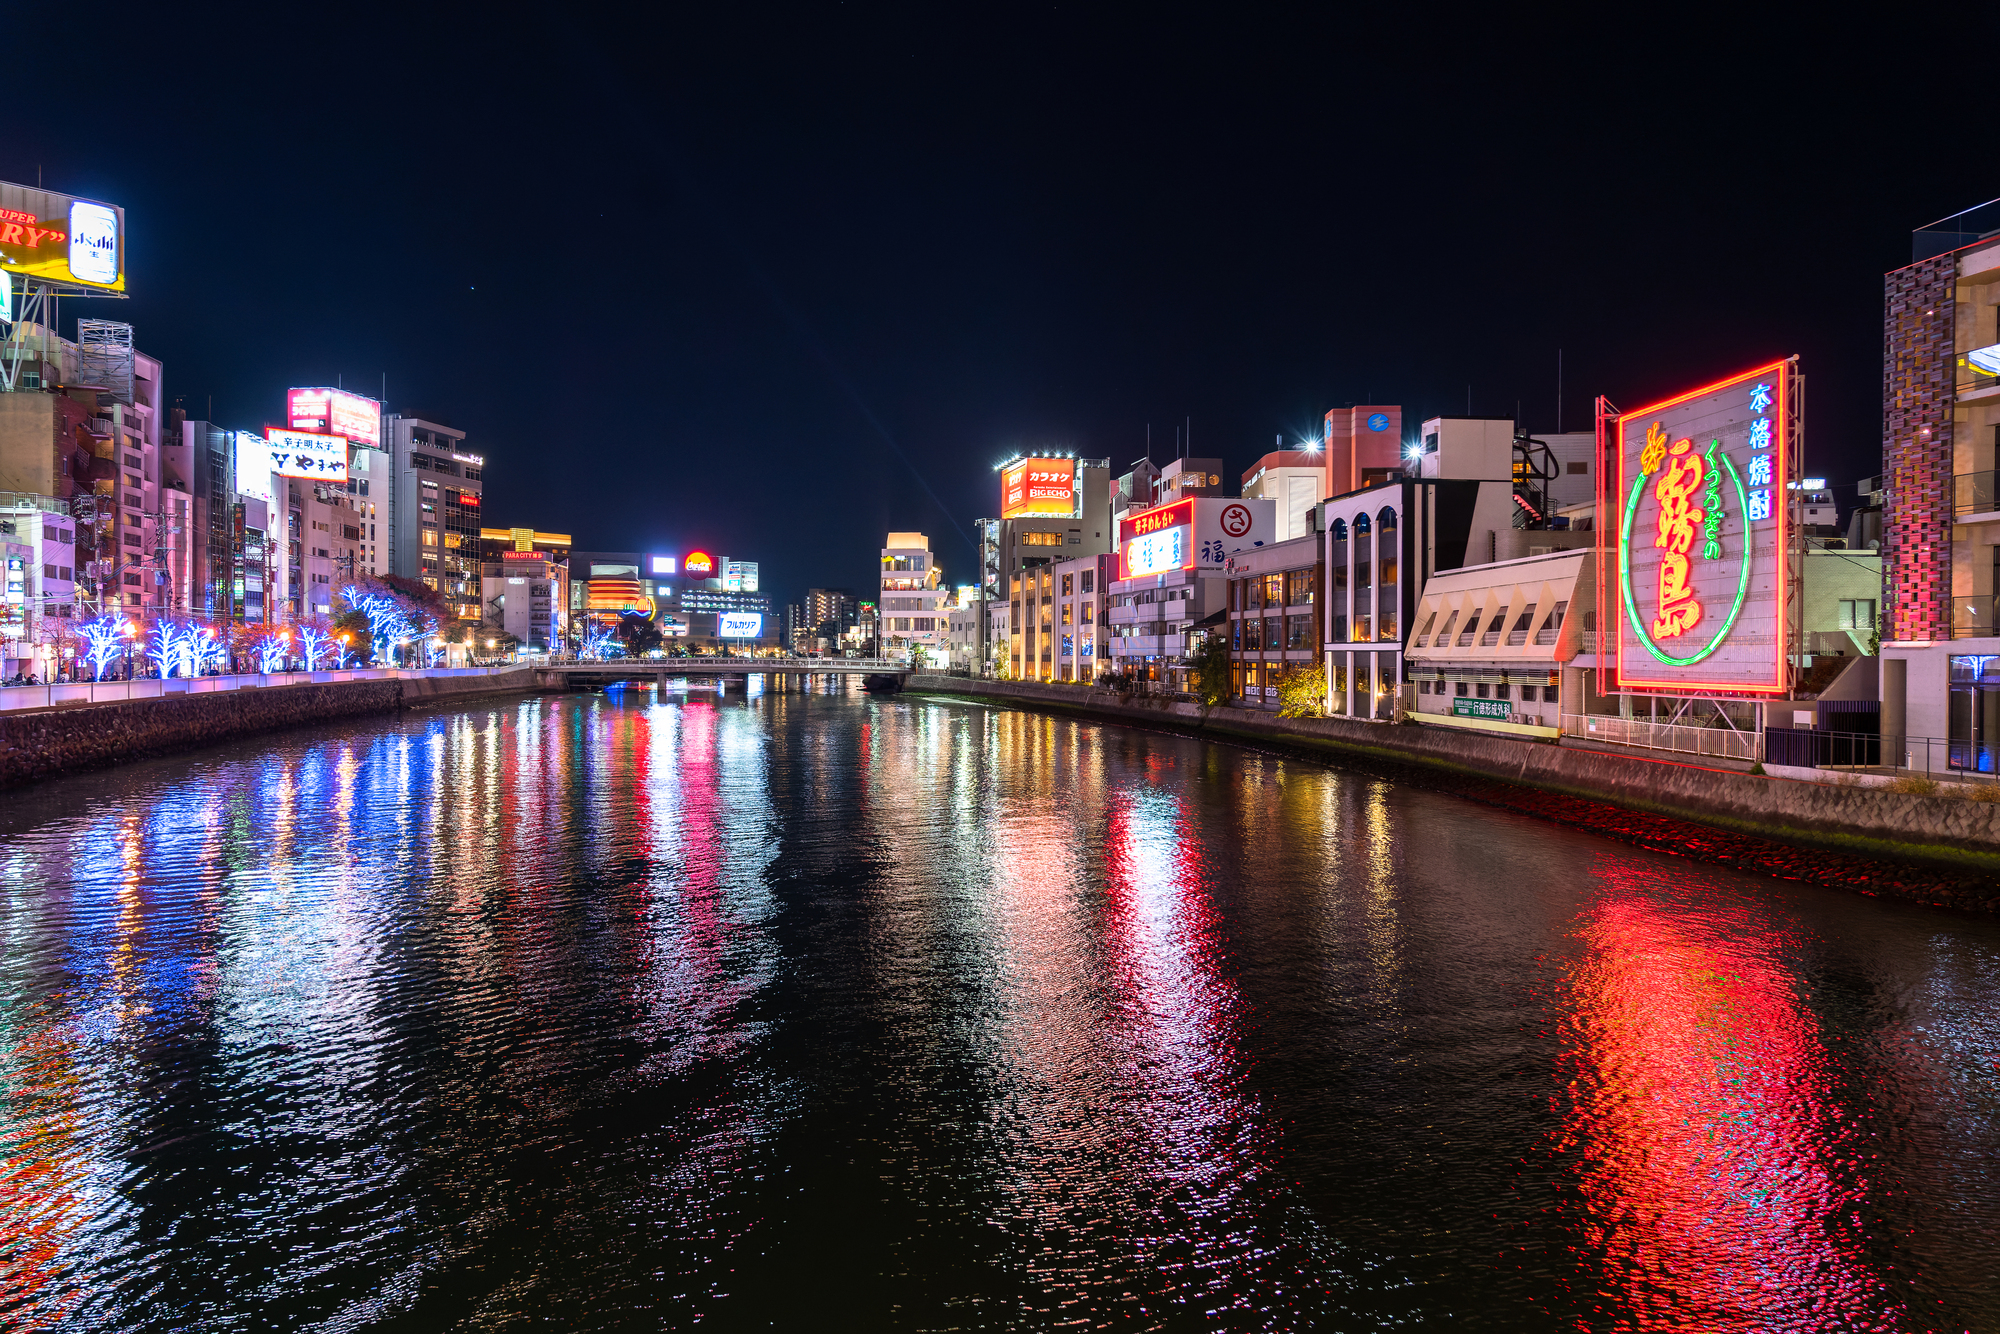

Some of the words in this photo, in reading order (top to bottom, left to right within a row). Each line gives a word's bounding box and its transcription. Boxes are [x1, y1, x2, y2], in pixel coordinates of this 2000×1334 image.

[0, 208, 37, 225] UPER
[284, 437, 334, 451] 辛子明太子
[1748, 383, 1773, 520] 本格焼酎
[295, 454, 346, 472] やまや
[1029, 472, 1070, 482] カラオケ
[1029, 489, 1046, 498] BIG
[1047, 489, 1071, 499] ECHO
[1704, 438, 1724, 560] くつろぎの
[1135, 512, 1174, 536] 辛子めんたい
